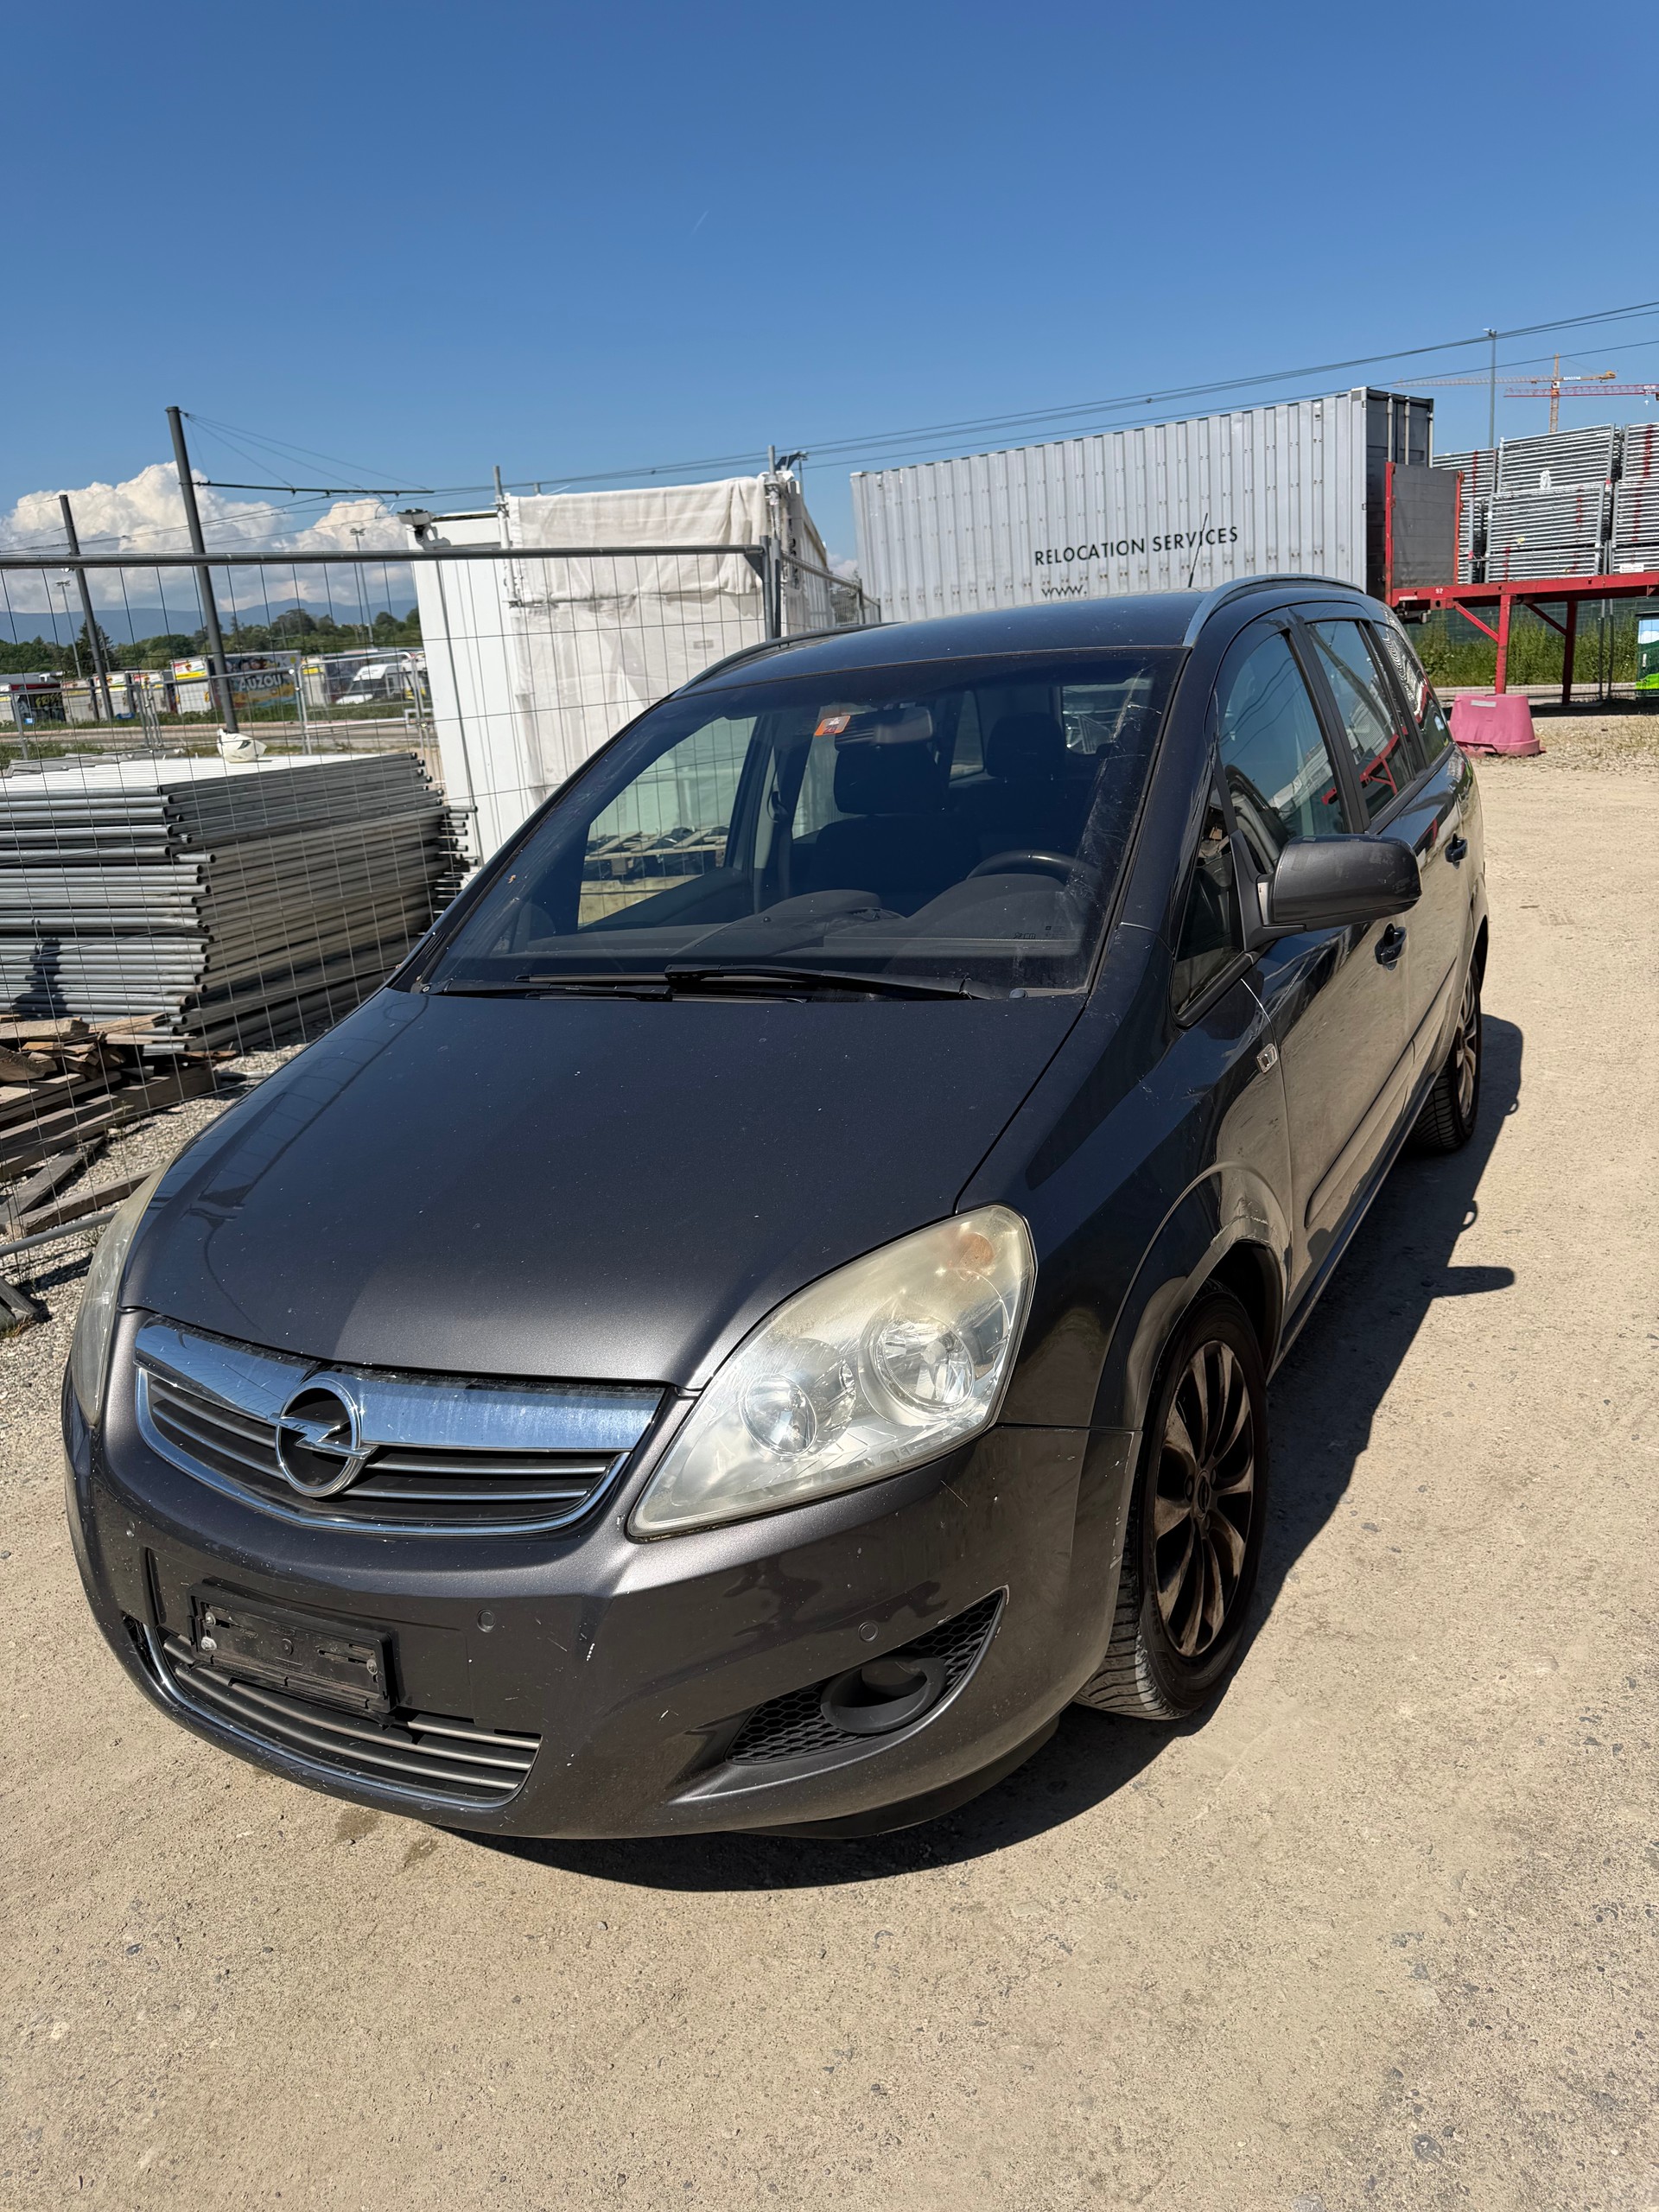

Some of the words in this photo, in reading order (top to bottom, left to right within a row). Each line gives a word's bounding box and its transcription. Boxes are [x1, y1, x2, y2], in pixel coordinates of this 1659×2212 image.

[1035, 538, 1145, 566] RELOCATION
[1153, 527, 1238, 551] SERVICES
[240, 675, 282, 690] AUZOU
